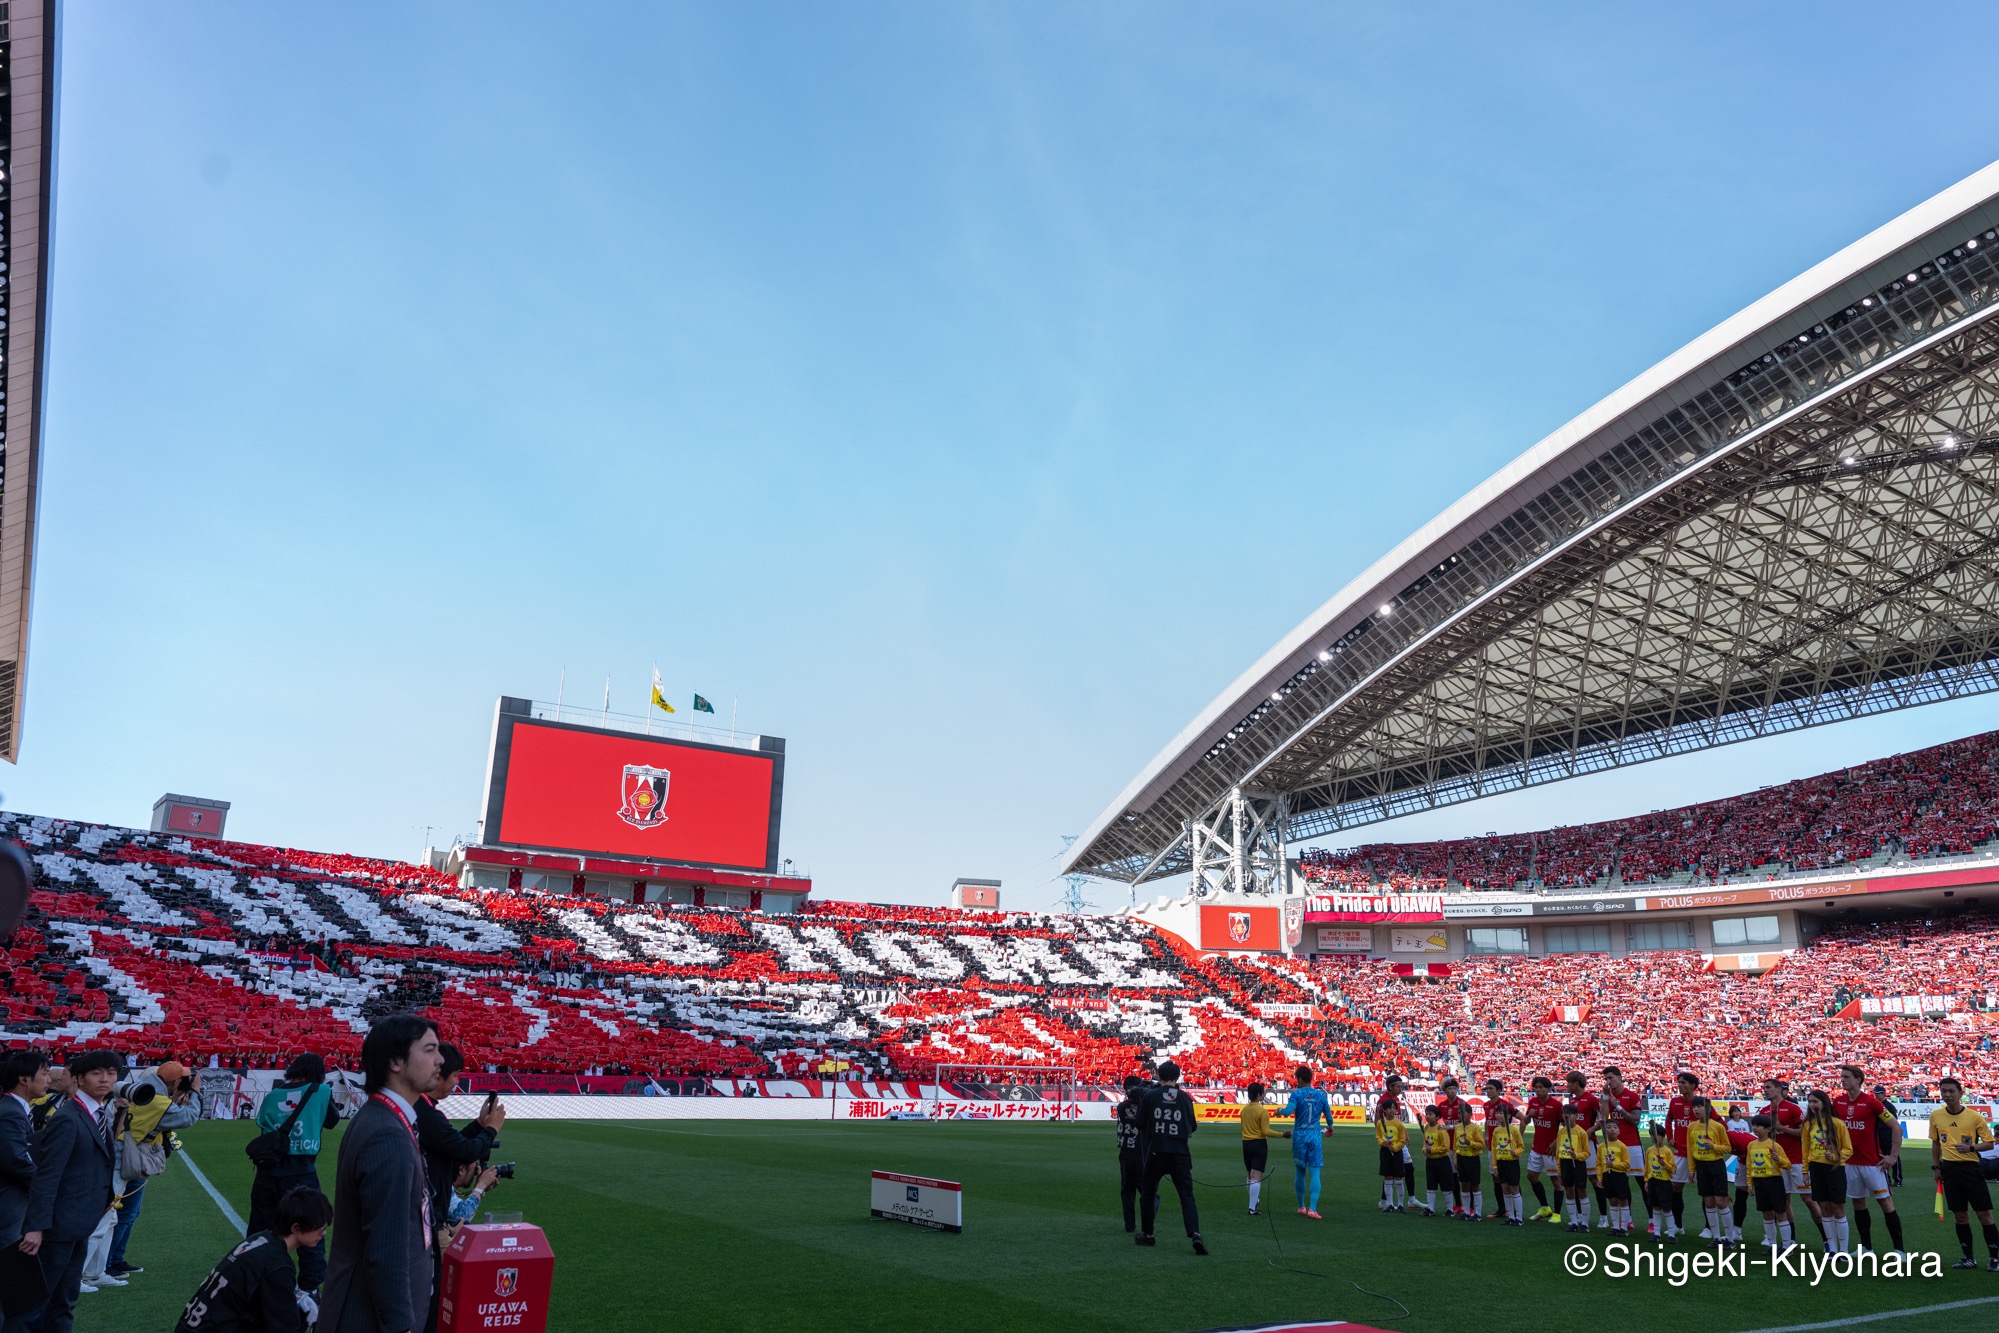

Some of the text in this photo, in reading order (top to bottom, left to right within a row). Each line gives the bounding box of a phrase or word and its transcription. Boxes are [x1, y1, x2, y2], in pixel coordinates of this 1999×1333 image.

[1768, 879, 1852, 900] POLUS ポラスグループ
[1305, 895, 1442, 912] The Pride of URAWA
[1659, 894, 1737, 908] POLUS ポラスグループ
[850, 1101, 1083, 1119] 浦和レッズ オフィシャルチケットサイト
[1154, 1108, 1182, 1121] 020
[1205, 1109, 1240, 1118] DHL
[1308, 1103, 1312, 1123] 1
[1155, 1122, 1178, 1135] HB
[1842, 1119, 1865, 1130] OLUS
[908, 1190, 918, 1199] MCS
[478, 1301, 528, 1315] URAWA
[483, 1314, 521, 1328] REDS
